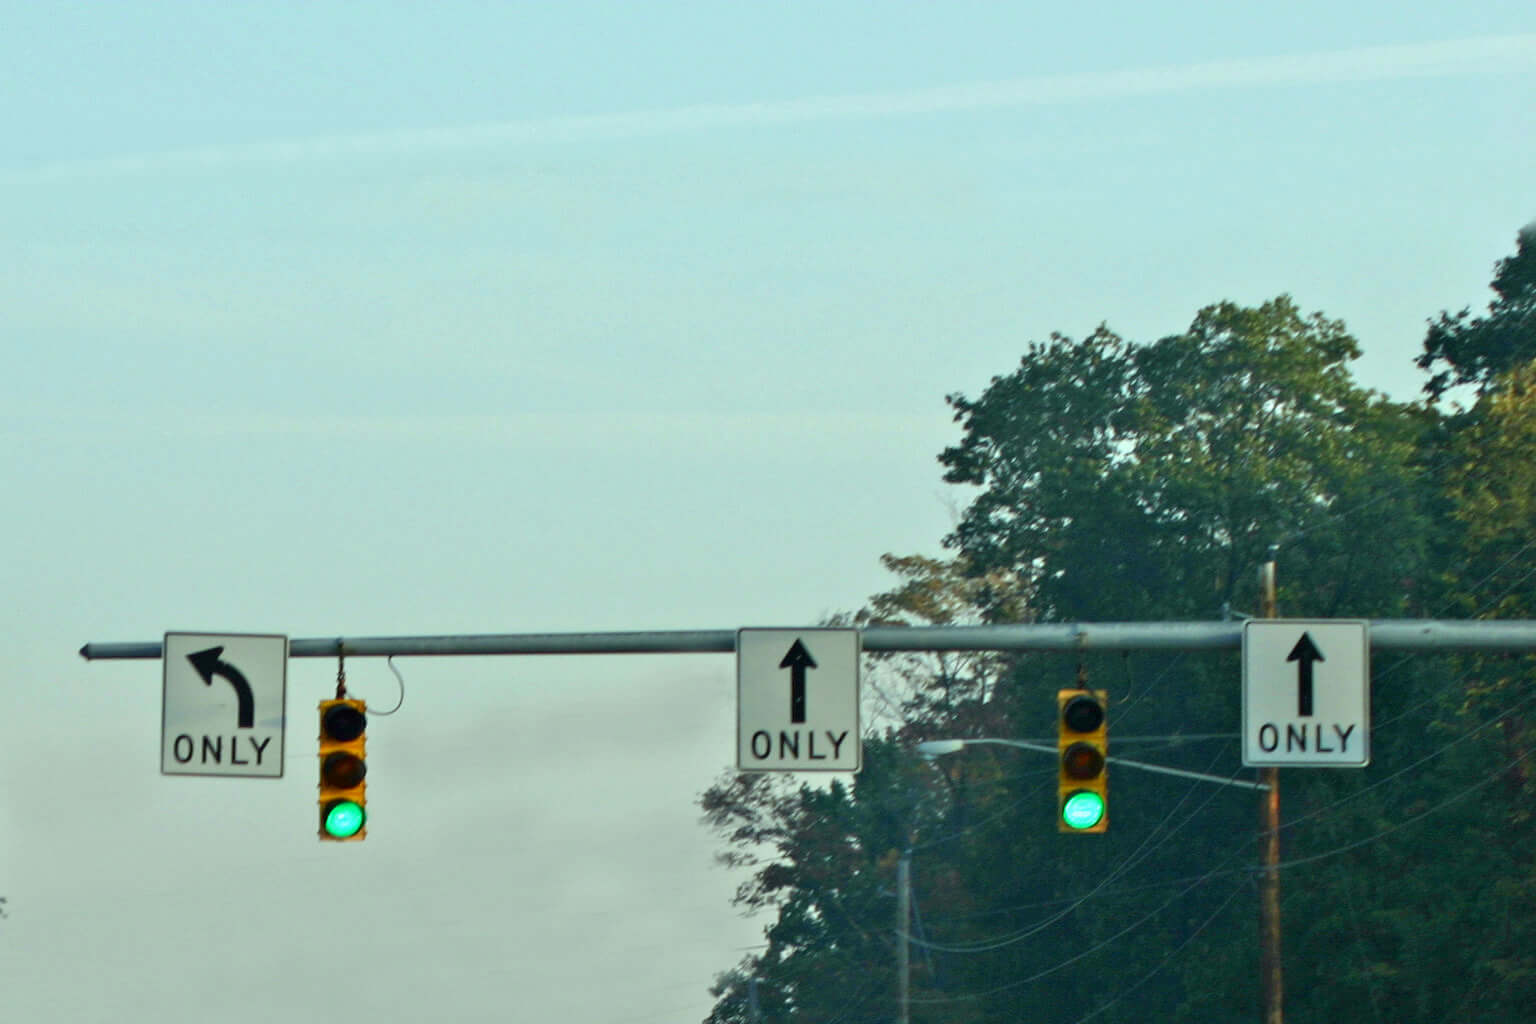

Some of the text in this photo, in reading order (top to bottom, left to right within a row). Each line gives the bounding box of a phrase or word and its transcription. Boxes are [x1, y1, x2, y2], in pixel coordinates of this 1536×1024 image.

[173, 733, 273, 766] ONLY
[750, 729, 849, 760] ONLY
[1258, 722, 1356, 753] ONLY
